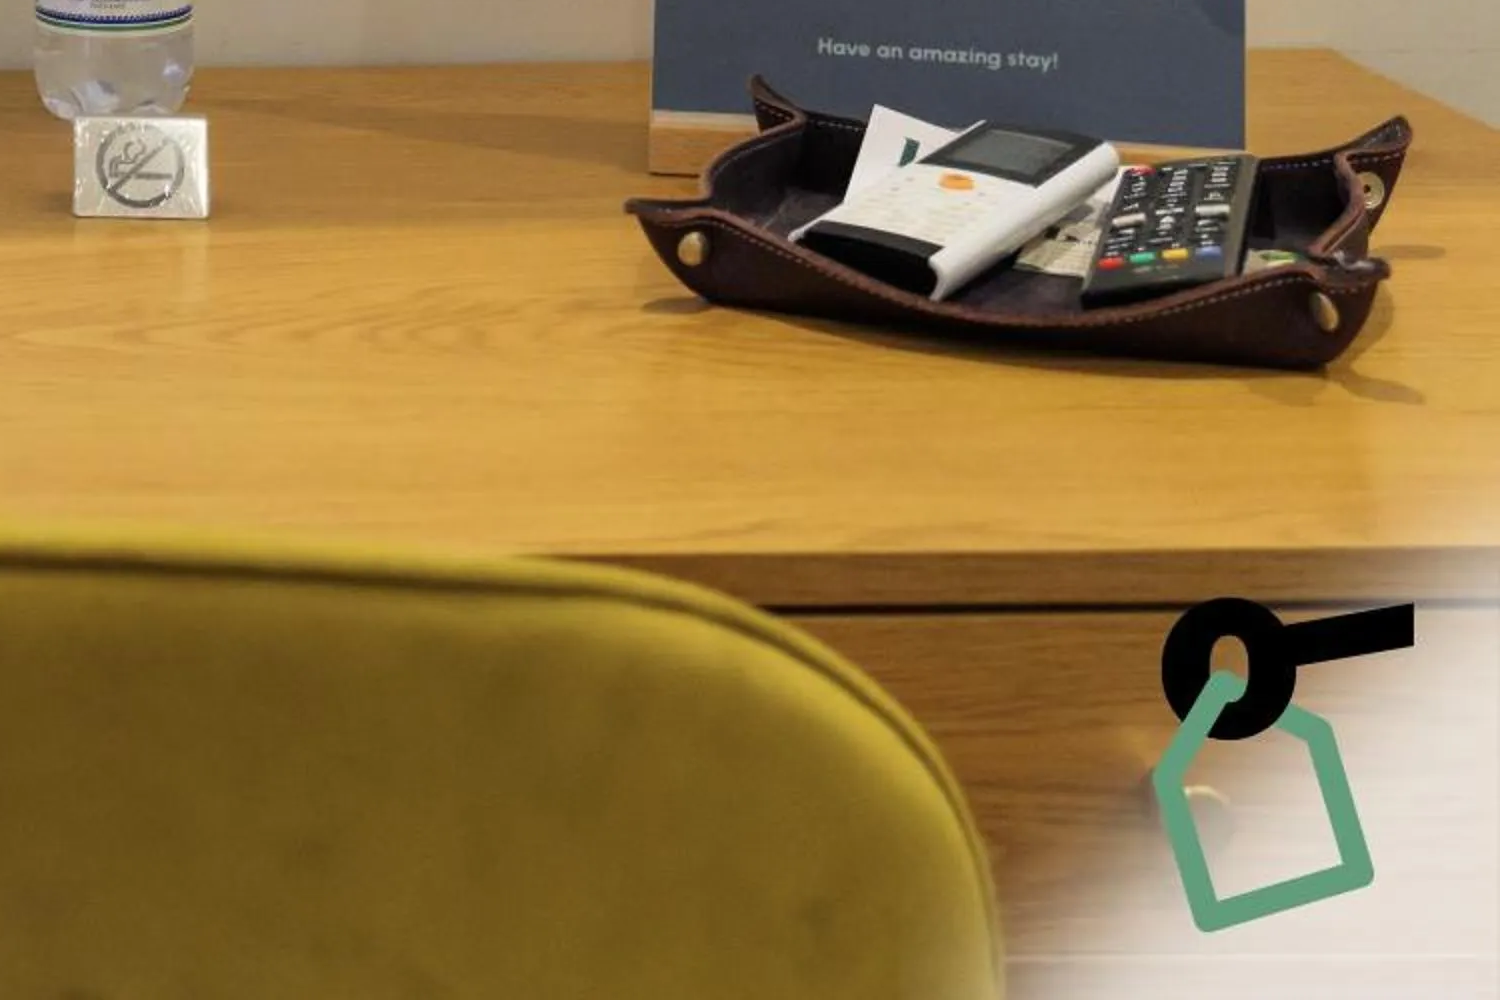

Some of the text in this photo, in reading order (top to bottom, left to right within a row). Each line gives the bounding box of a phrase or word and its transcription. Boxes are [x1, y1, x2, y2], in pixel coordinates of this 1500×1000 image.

[817, 38, 1060, 73] Have an amazing stay!
